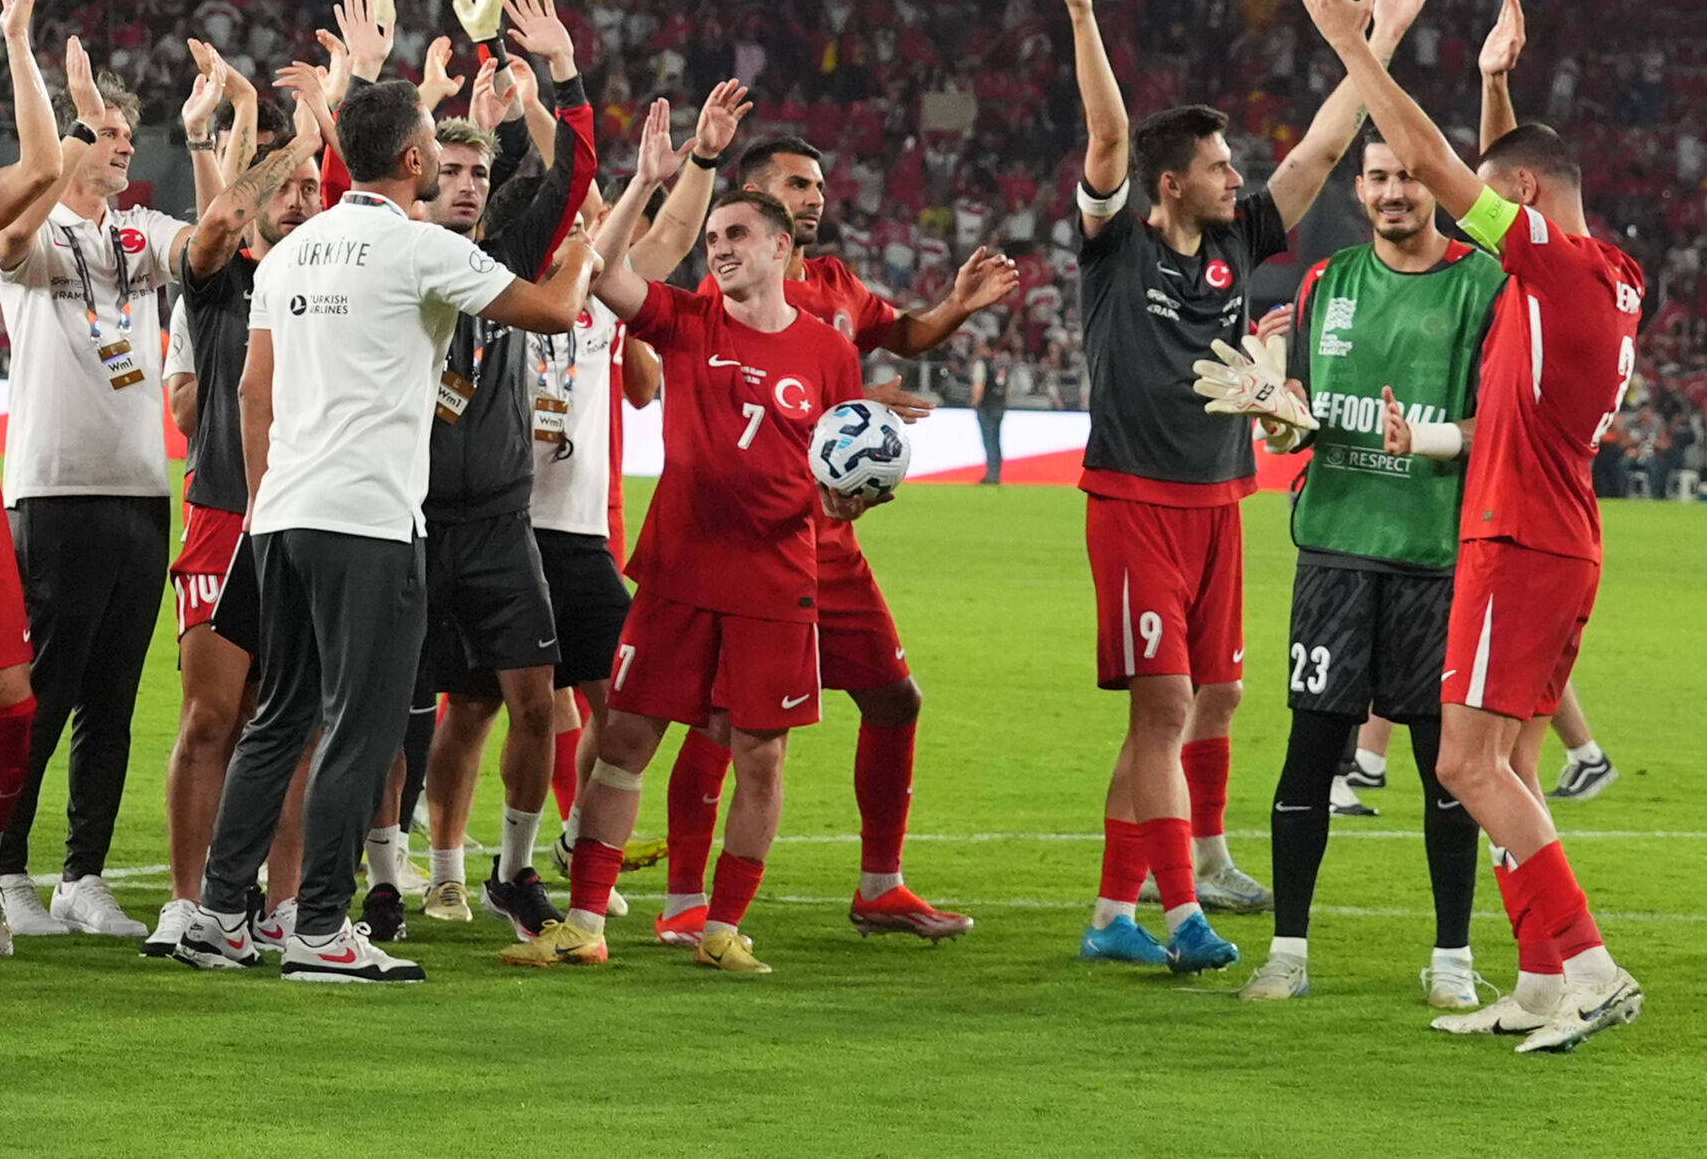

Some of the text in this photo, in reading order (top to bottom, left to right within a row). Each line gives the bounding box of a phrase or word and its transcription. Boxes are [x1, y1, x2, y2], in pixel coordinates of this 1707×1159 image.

[288, 237, 370, 266] ÜRKİYE
[737, 402, 765, 450] 7
[1349, 451, 1412, 473] RESPECT
[1140, 611, 1162, 658] 9
[614, 644, 636, 691] 7
[1290, 642, 1331, 694] 23
